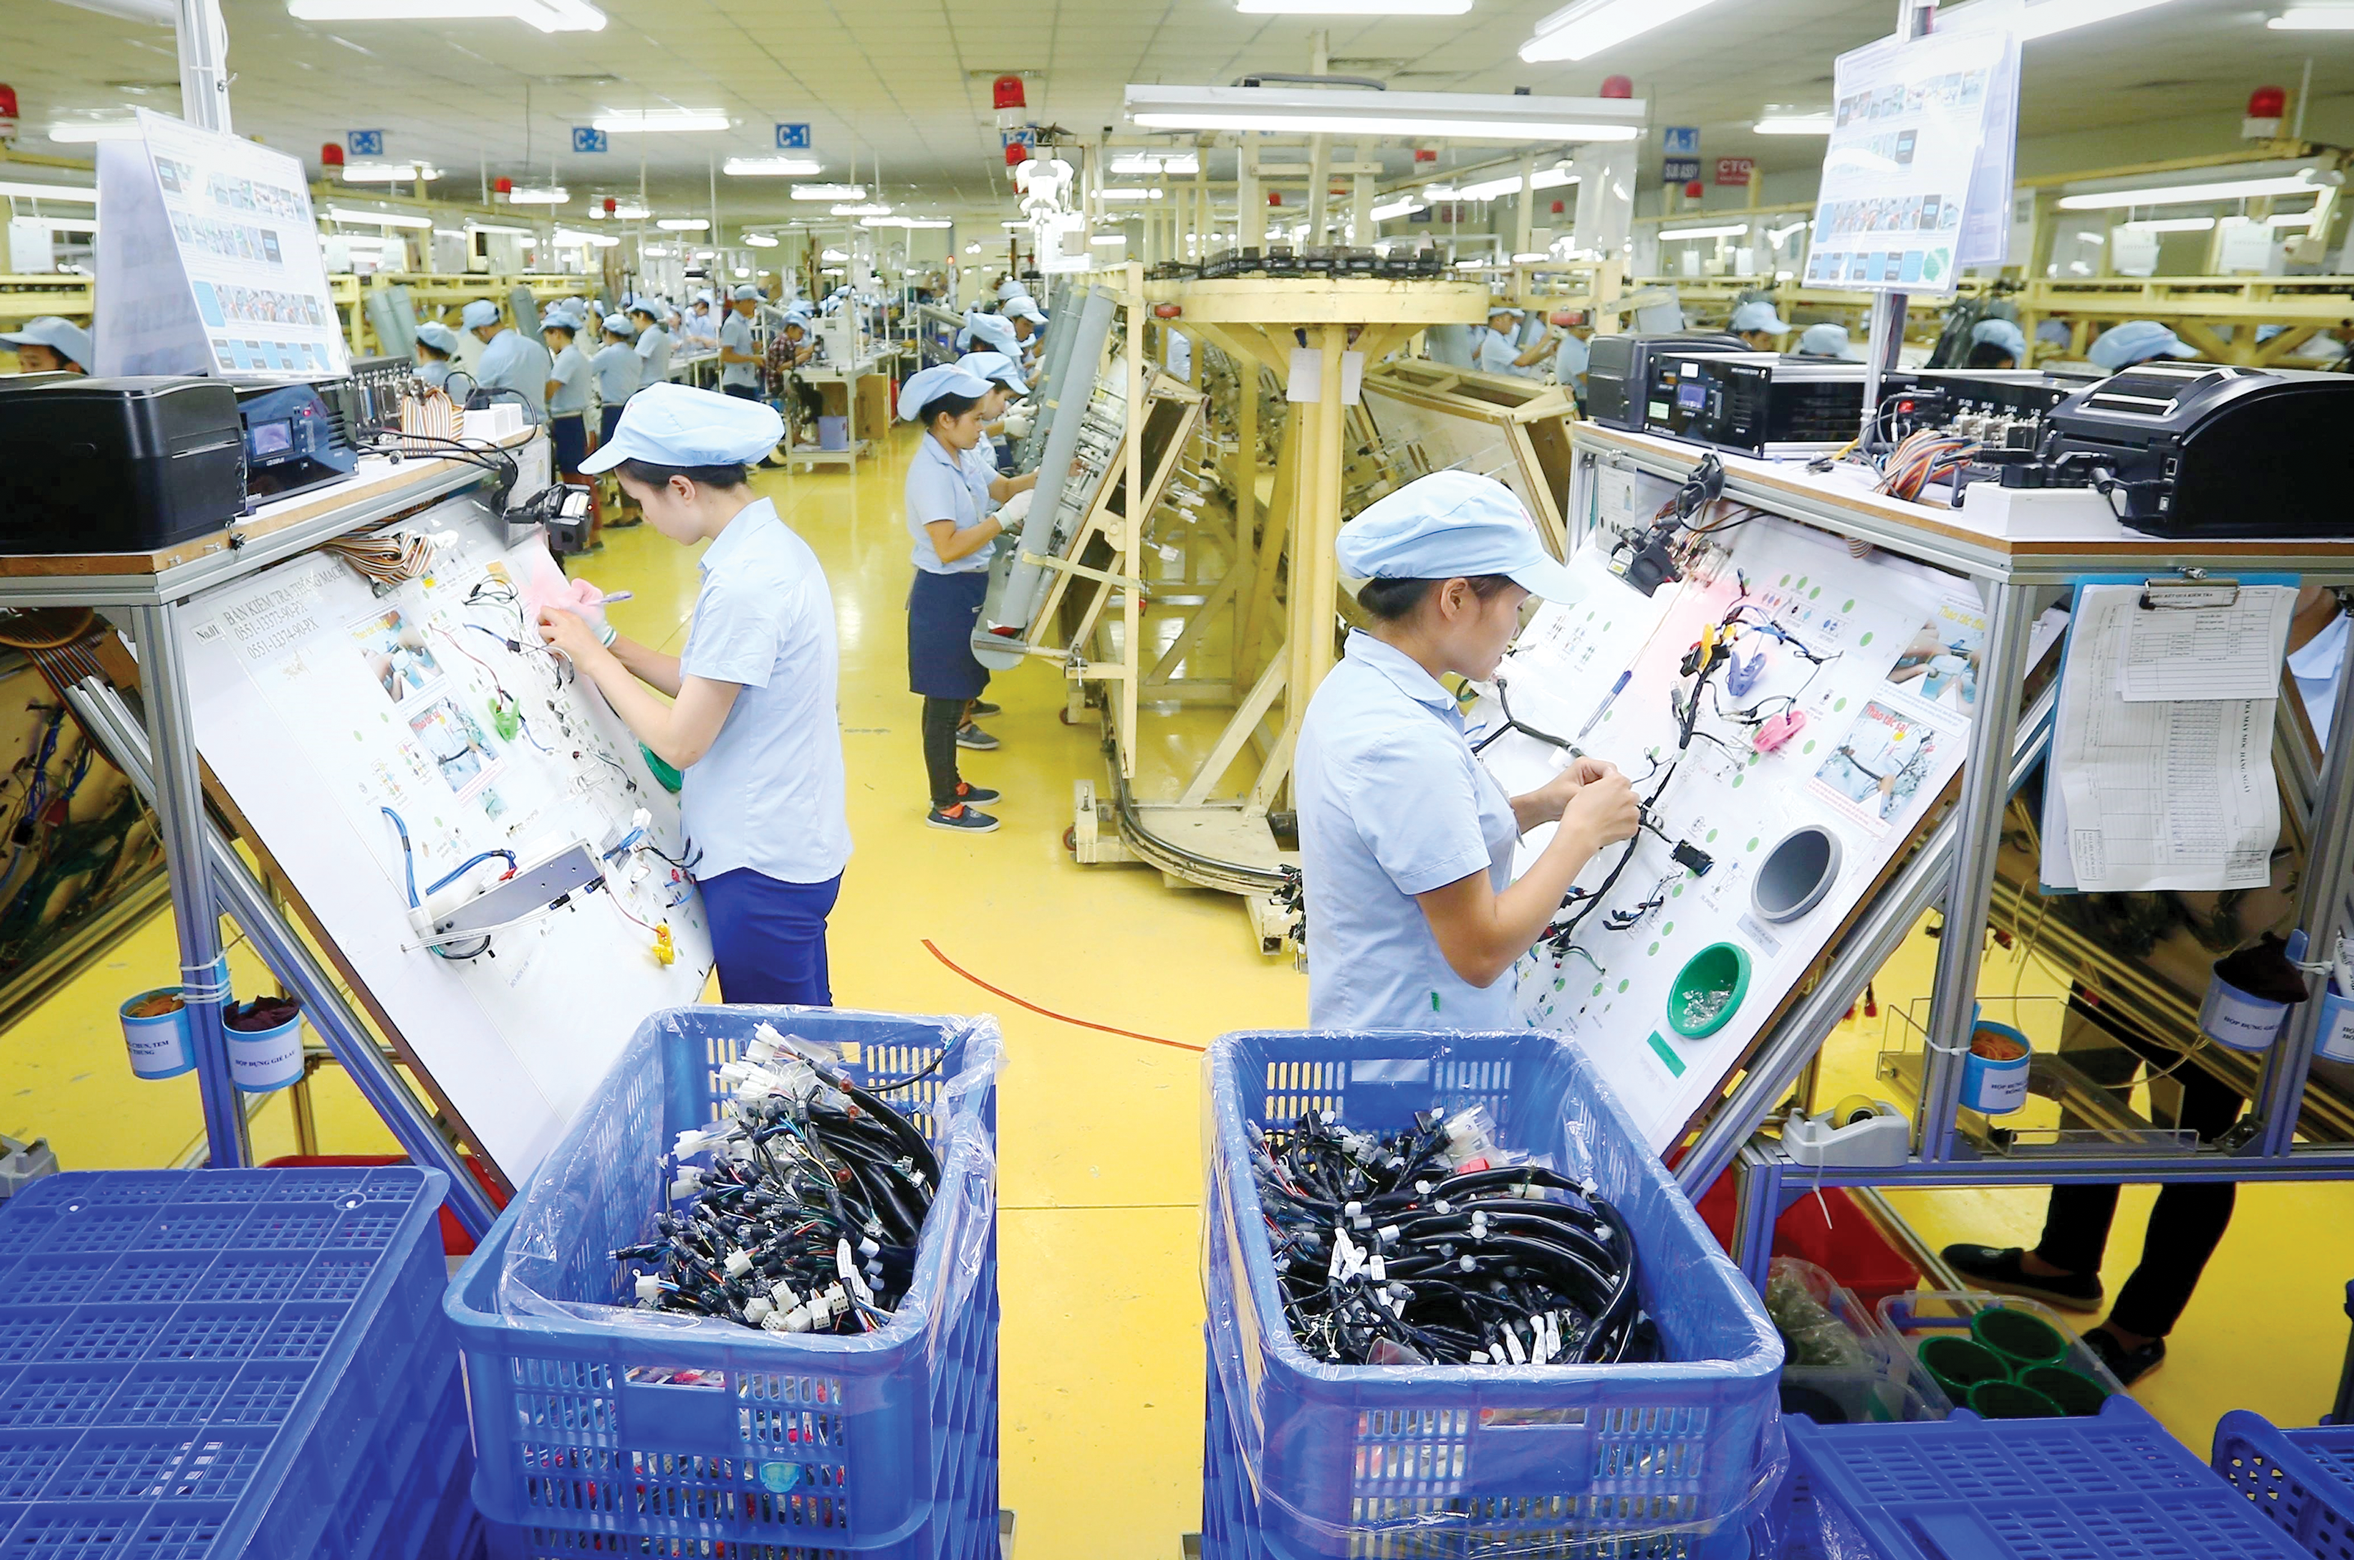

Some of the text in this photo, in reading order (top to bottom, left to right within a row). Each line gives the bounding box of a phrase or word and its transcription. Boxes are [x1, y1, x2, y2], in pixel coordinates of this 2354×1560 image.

[350, 132, 380, 152] C-3
[575, 129, 604, 150] C-2
[779, 126, 808, 146] C-1
[1668, 130, 1696, 149] A-1
[270, 588, 293, 608] TRA
[195, 624, 220, 643] No.01
[1864, 704, 1886, 723] Thao
